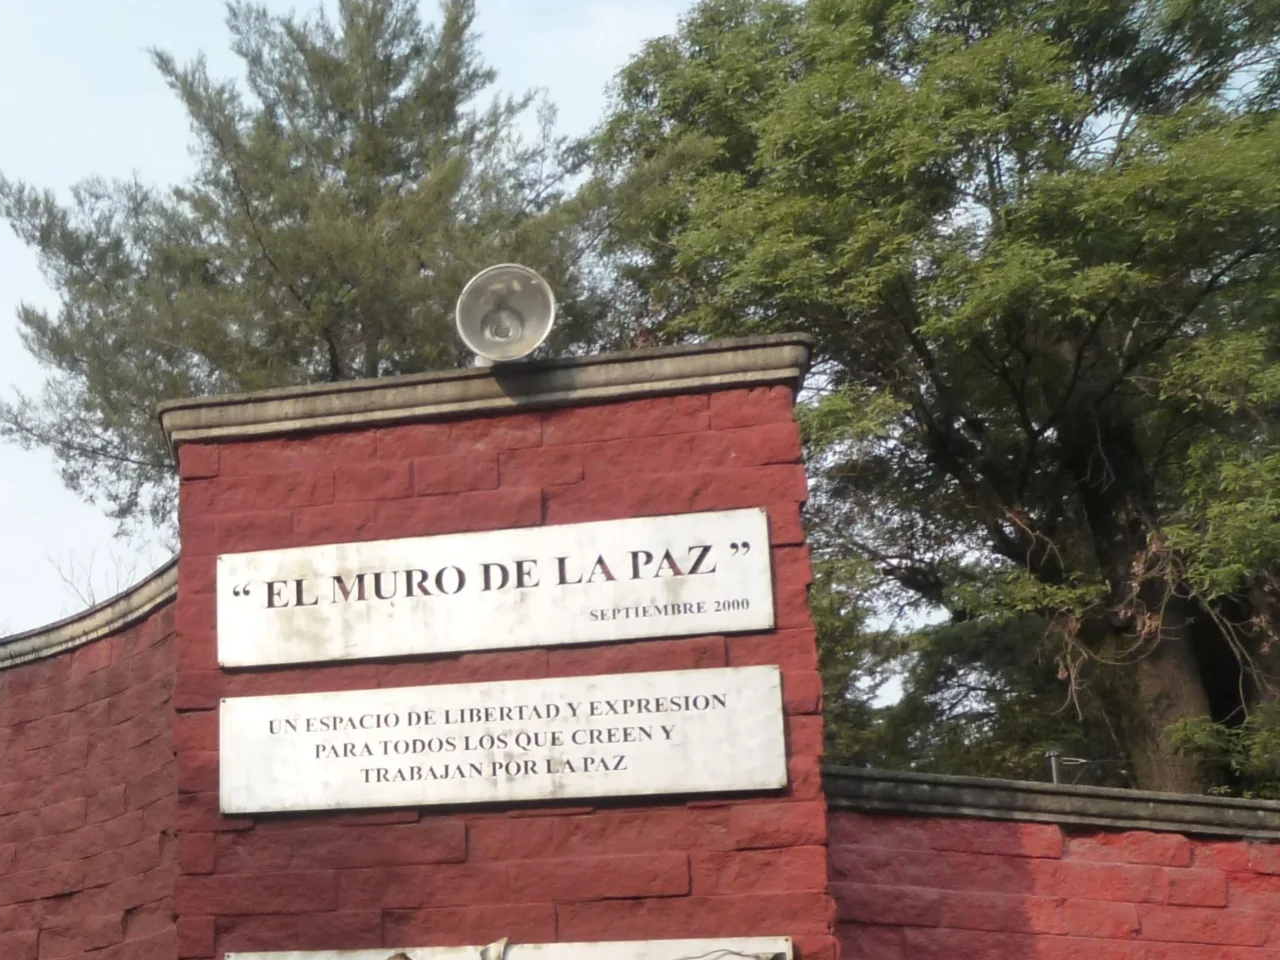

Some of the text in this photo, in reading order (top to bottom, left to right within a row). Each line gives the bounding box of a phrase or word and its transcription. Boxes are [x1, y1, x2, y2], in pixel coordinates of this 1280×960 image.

[331, 565, 467, 604] MURO
[480, 558, 540, 592] DE
[555, 554, 616, 586] LA
[590, 598, 749, 622] SEPTIEMBRE 2000
[269, 694, 728, 735] UN ESPACIO DE LIBERTAD Y EXPRESION
[315, 725, 676, 759] PARA TODOS LOS QUE CREEN Y
[361, 755, 628, 784] TRABAJAN POR LA PAZ
